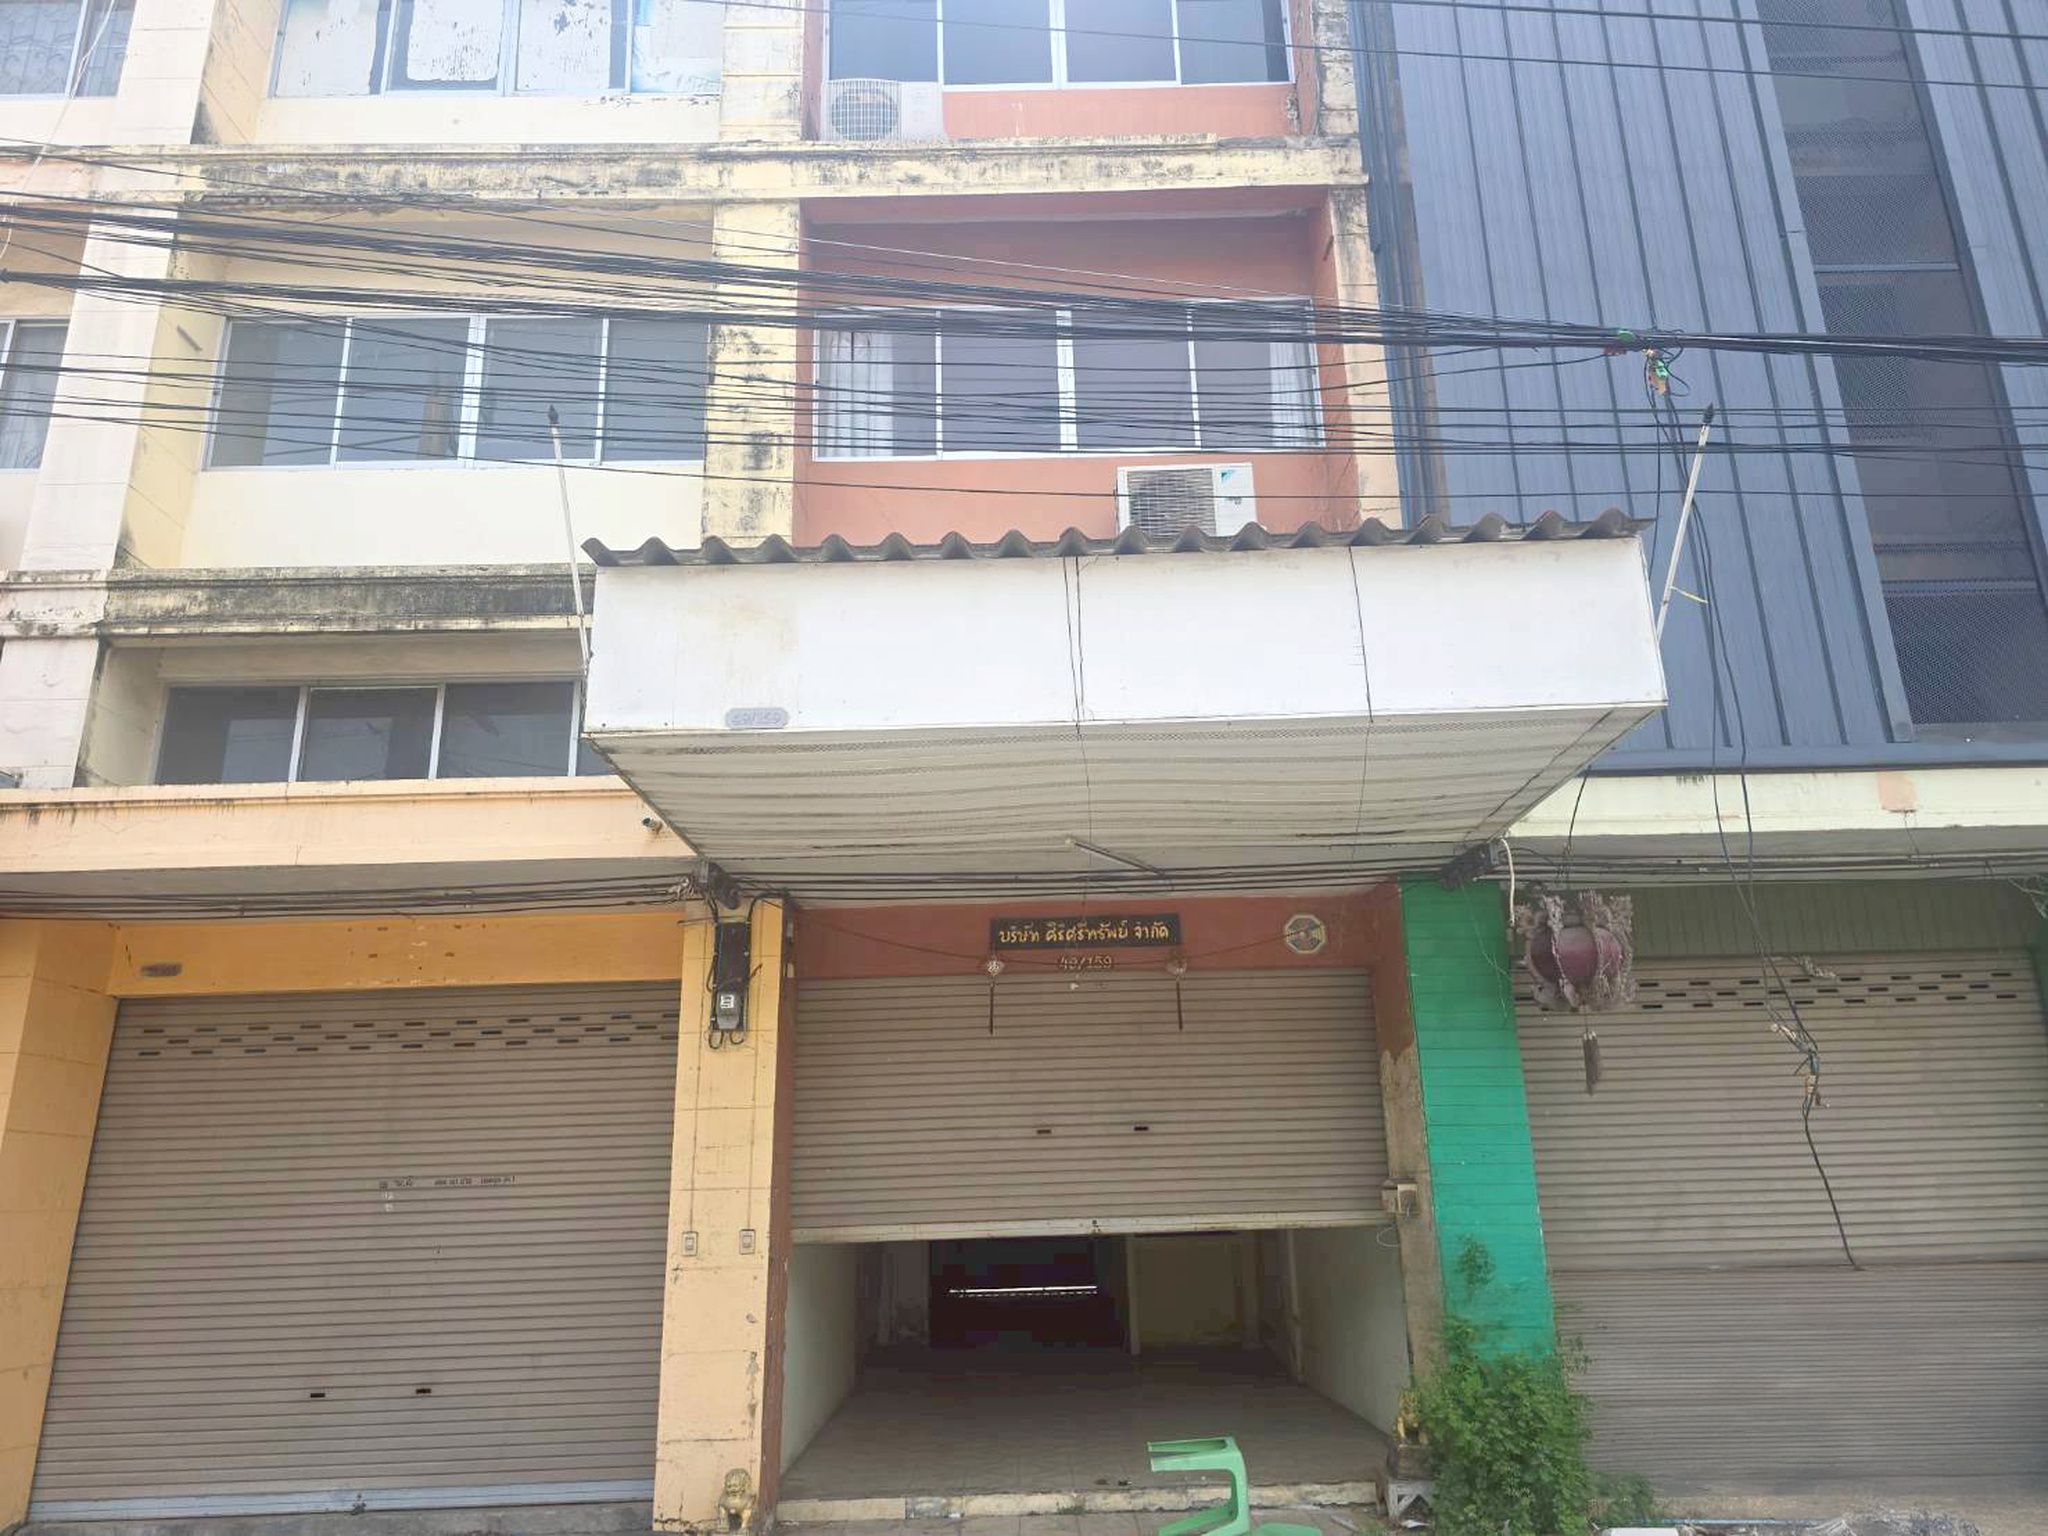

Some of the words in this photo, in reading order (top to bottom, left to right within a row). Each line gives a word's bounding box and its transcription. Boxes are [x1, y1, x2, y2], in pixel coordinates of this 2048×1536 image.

[998, 921, 1040, 943] บริษัท
[1133, 921, 1169, 940] จำกัด
